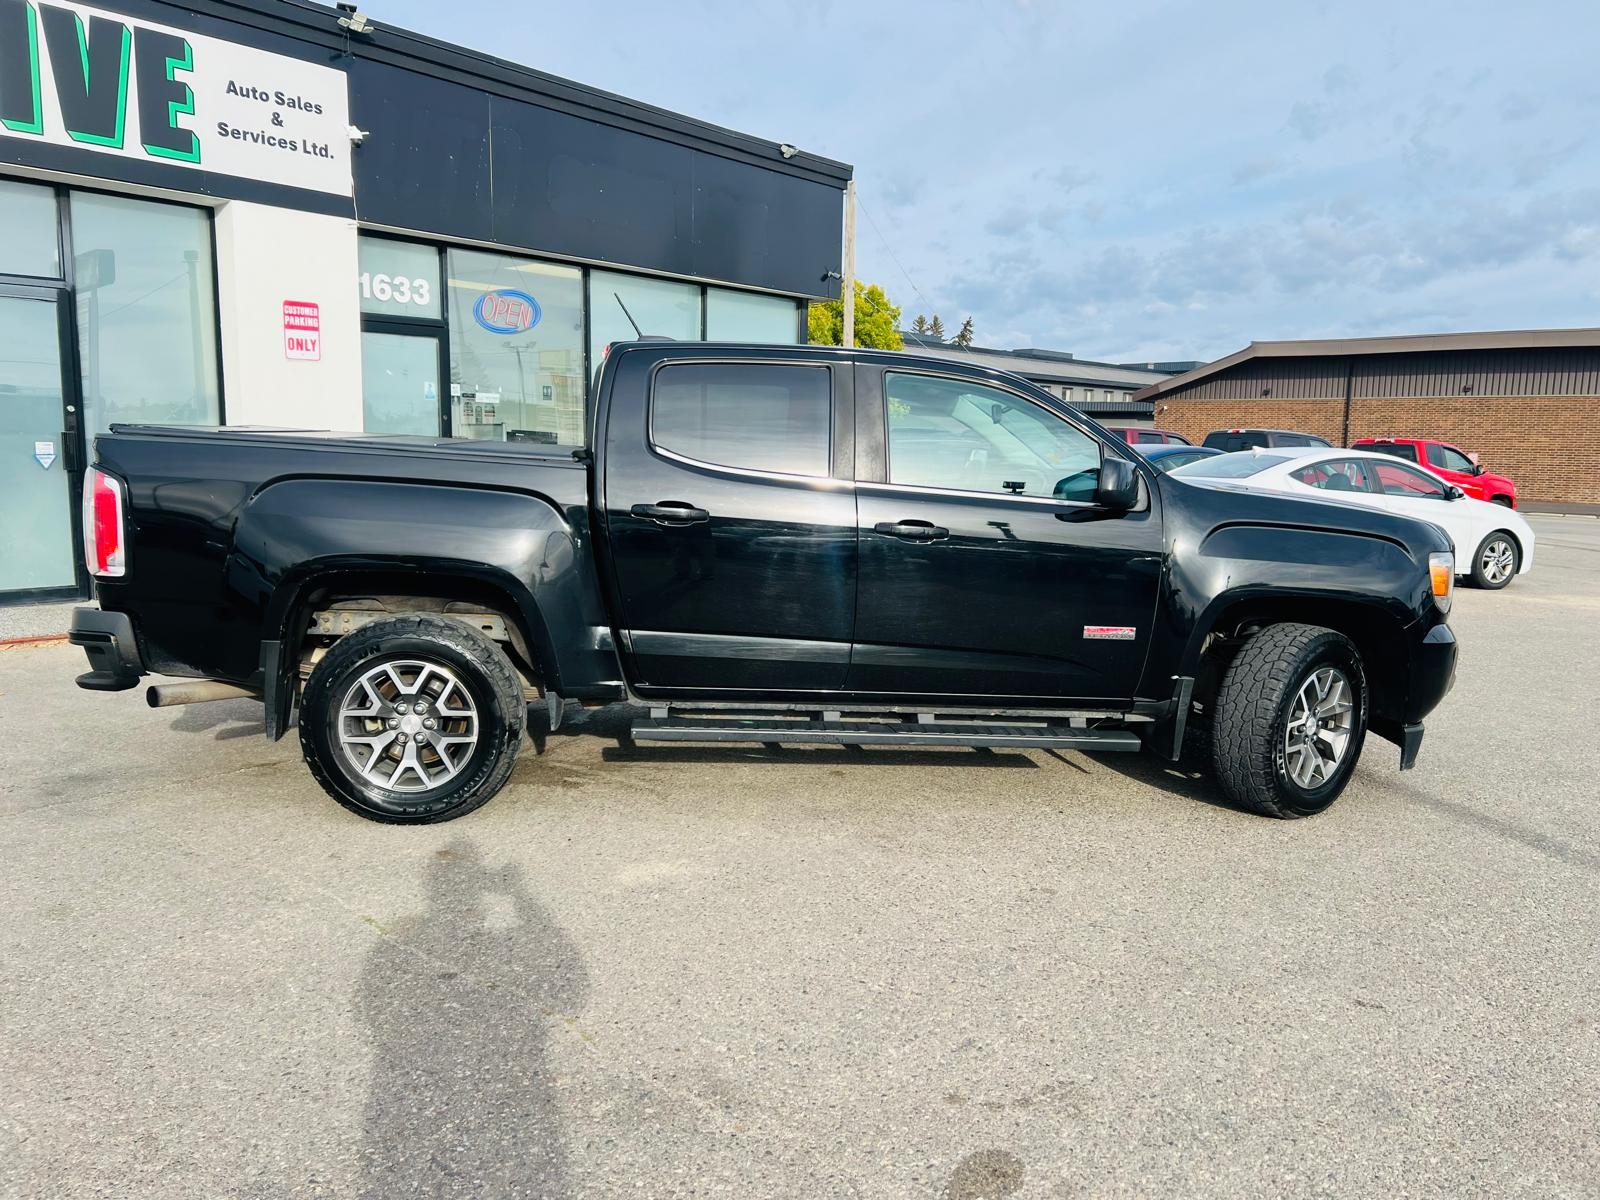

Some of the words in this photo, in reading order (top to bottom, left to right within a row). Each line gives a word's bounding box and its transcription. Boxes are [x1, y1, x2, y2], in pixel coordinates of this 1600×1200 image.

[225, 79, 270, 102] Auto
[274, 91, 323, 115] Sales
[271, 111, 284, 127] &
[217, 121, 298, 152] Services
[302, 139, 334, 159] Ltd.
[359, 272, 430, 305] 1633
[284, 305, 318, 317] CUSTOMER
[284, 316, 319, 328] PARKING
[481, 294, 532, 329] OPEN
[287, 337, 317, 352] ONLY
